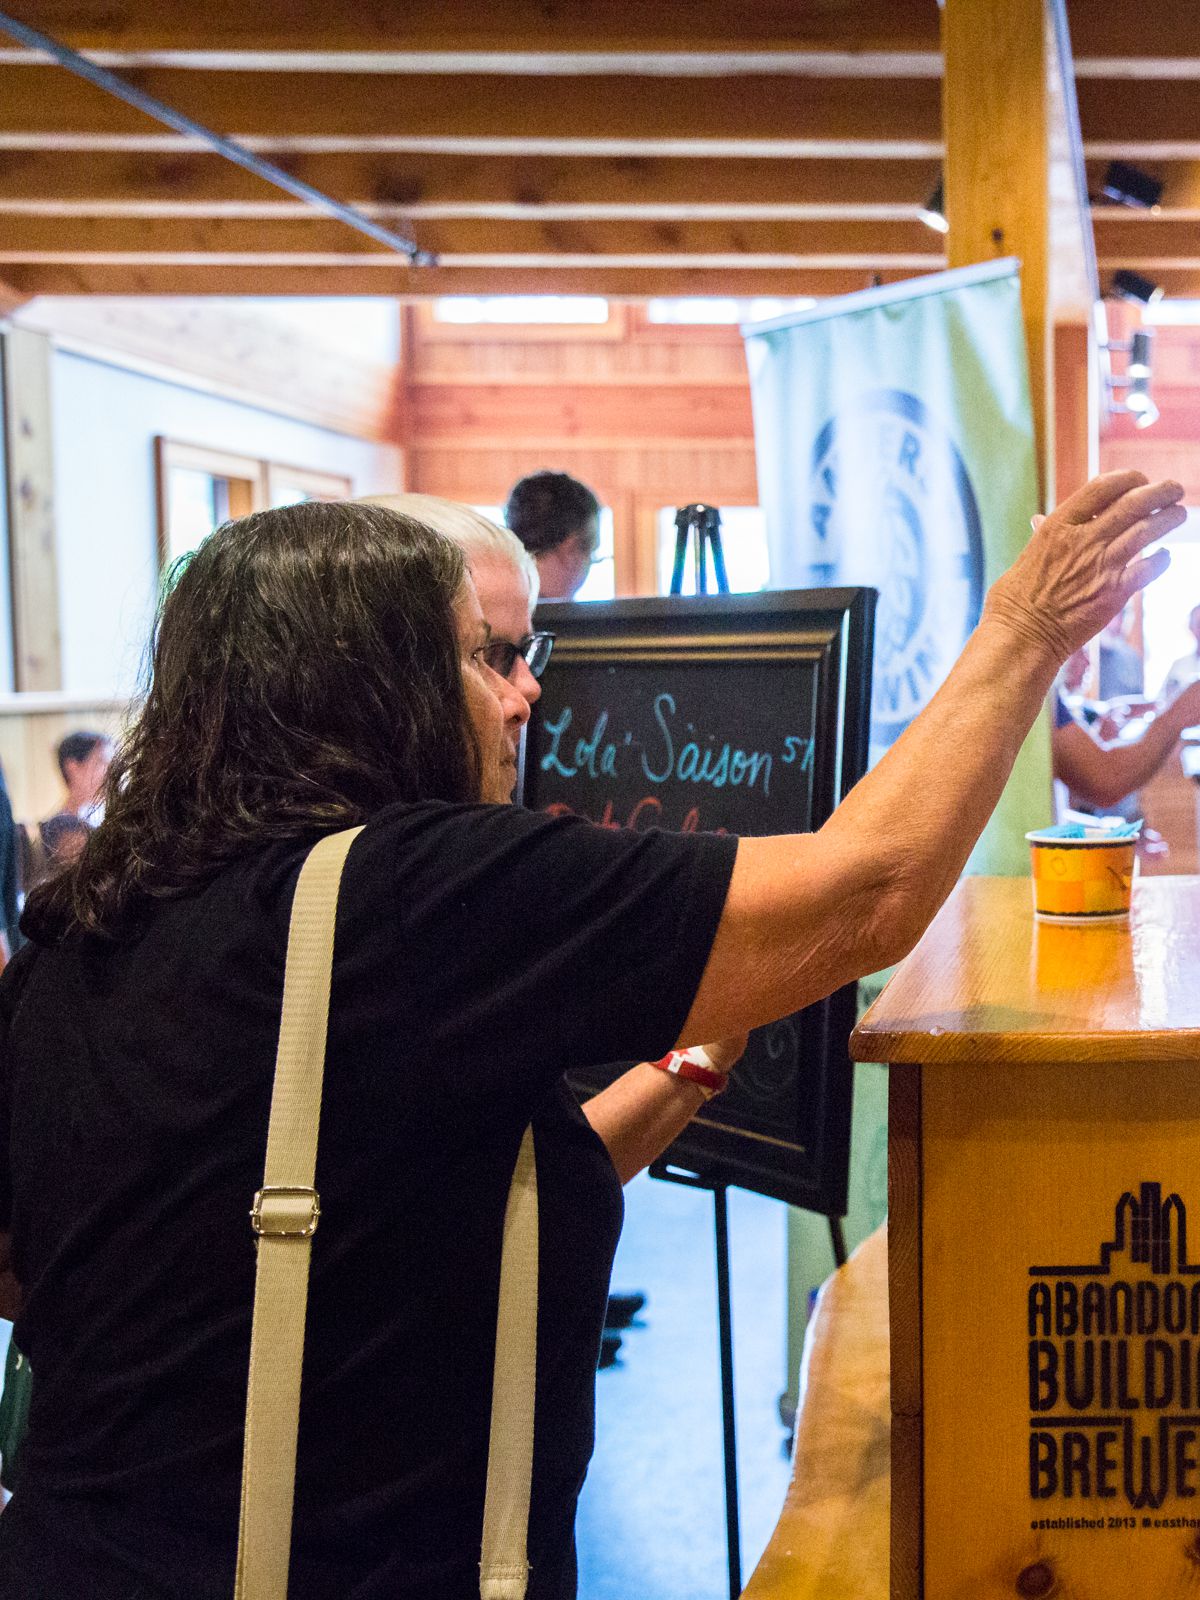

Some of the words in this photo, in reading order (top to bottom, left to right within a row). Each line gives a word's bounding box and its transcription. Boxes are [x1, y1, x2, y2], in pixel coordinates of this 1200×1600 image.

[642, 692, 772, 795] Saison
[1030, 1516, 1105, 1530] established
[1107, 1516, 1137, 1529] 2013
